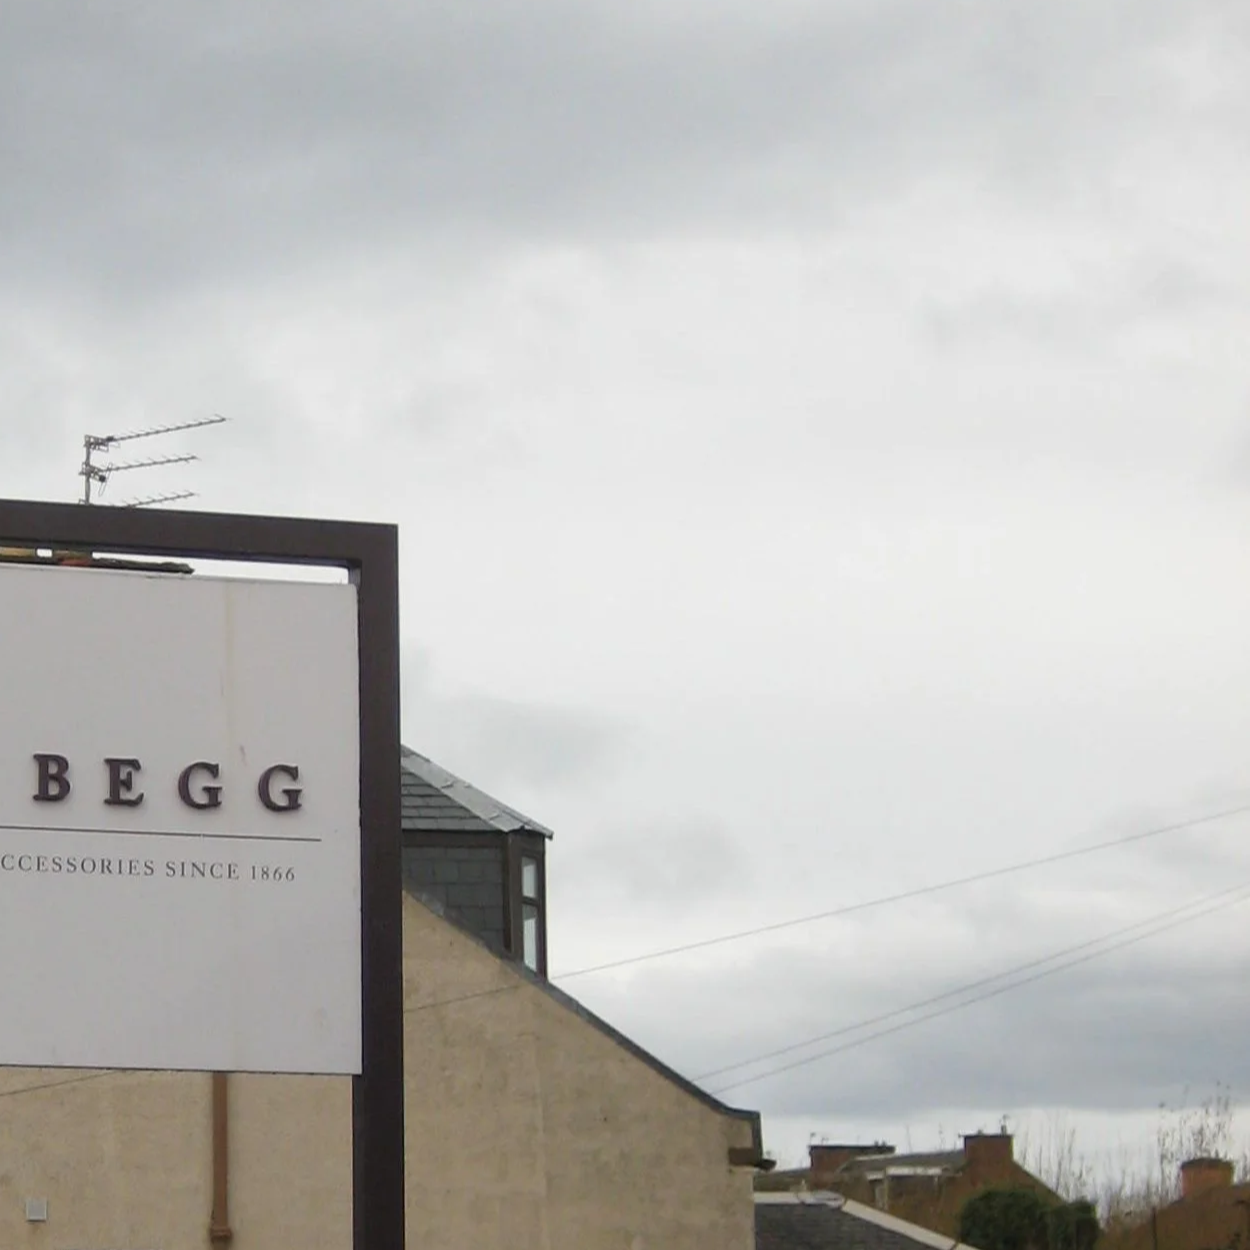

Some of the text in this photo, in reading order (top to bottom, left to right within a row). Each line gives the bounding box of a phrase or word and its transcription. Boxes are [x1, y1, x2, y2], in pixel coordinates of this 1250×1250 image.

[33, 754, 304, 813] BEGG
[166, 861, 240, 880] SINCE
[250, 865, 296, 882] 1866
